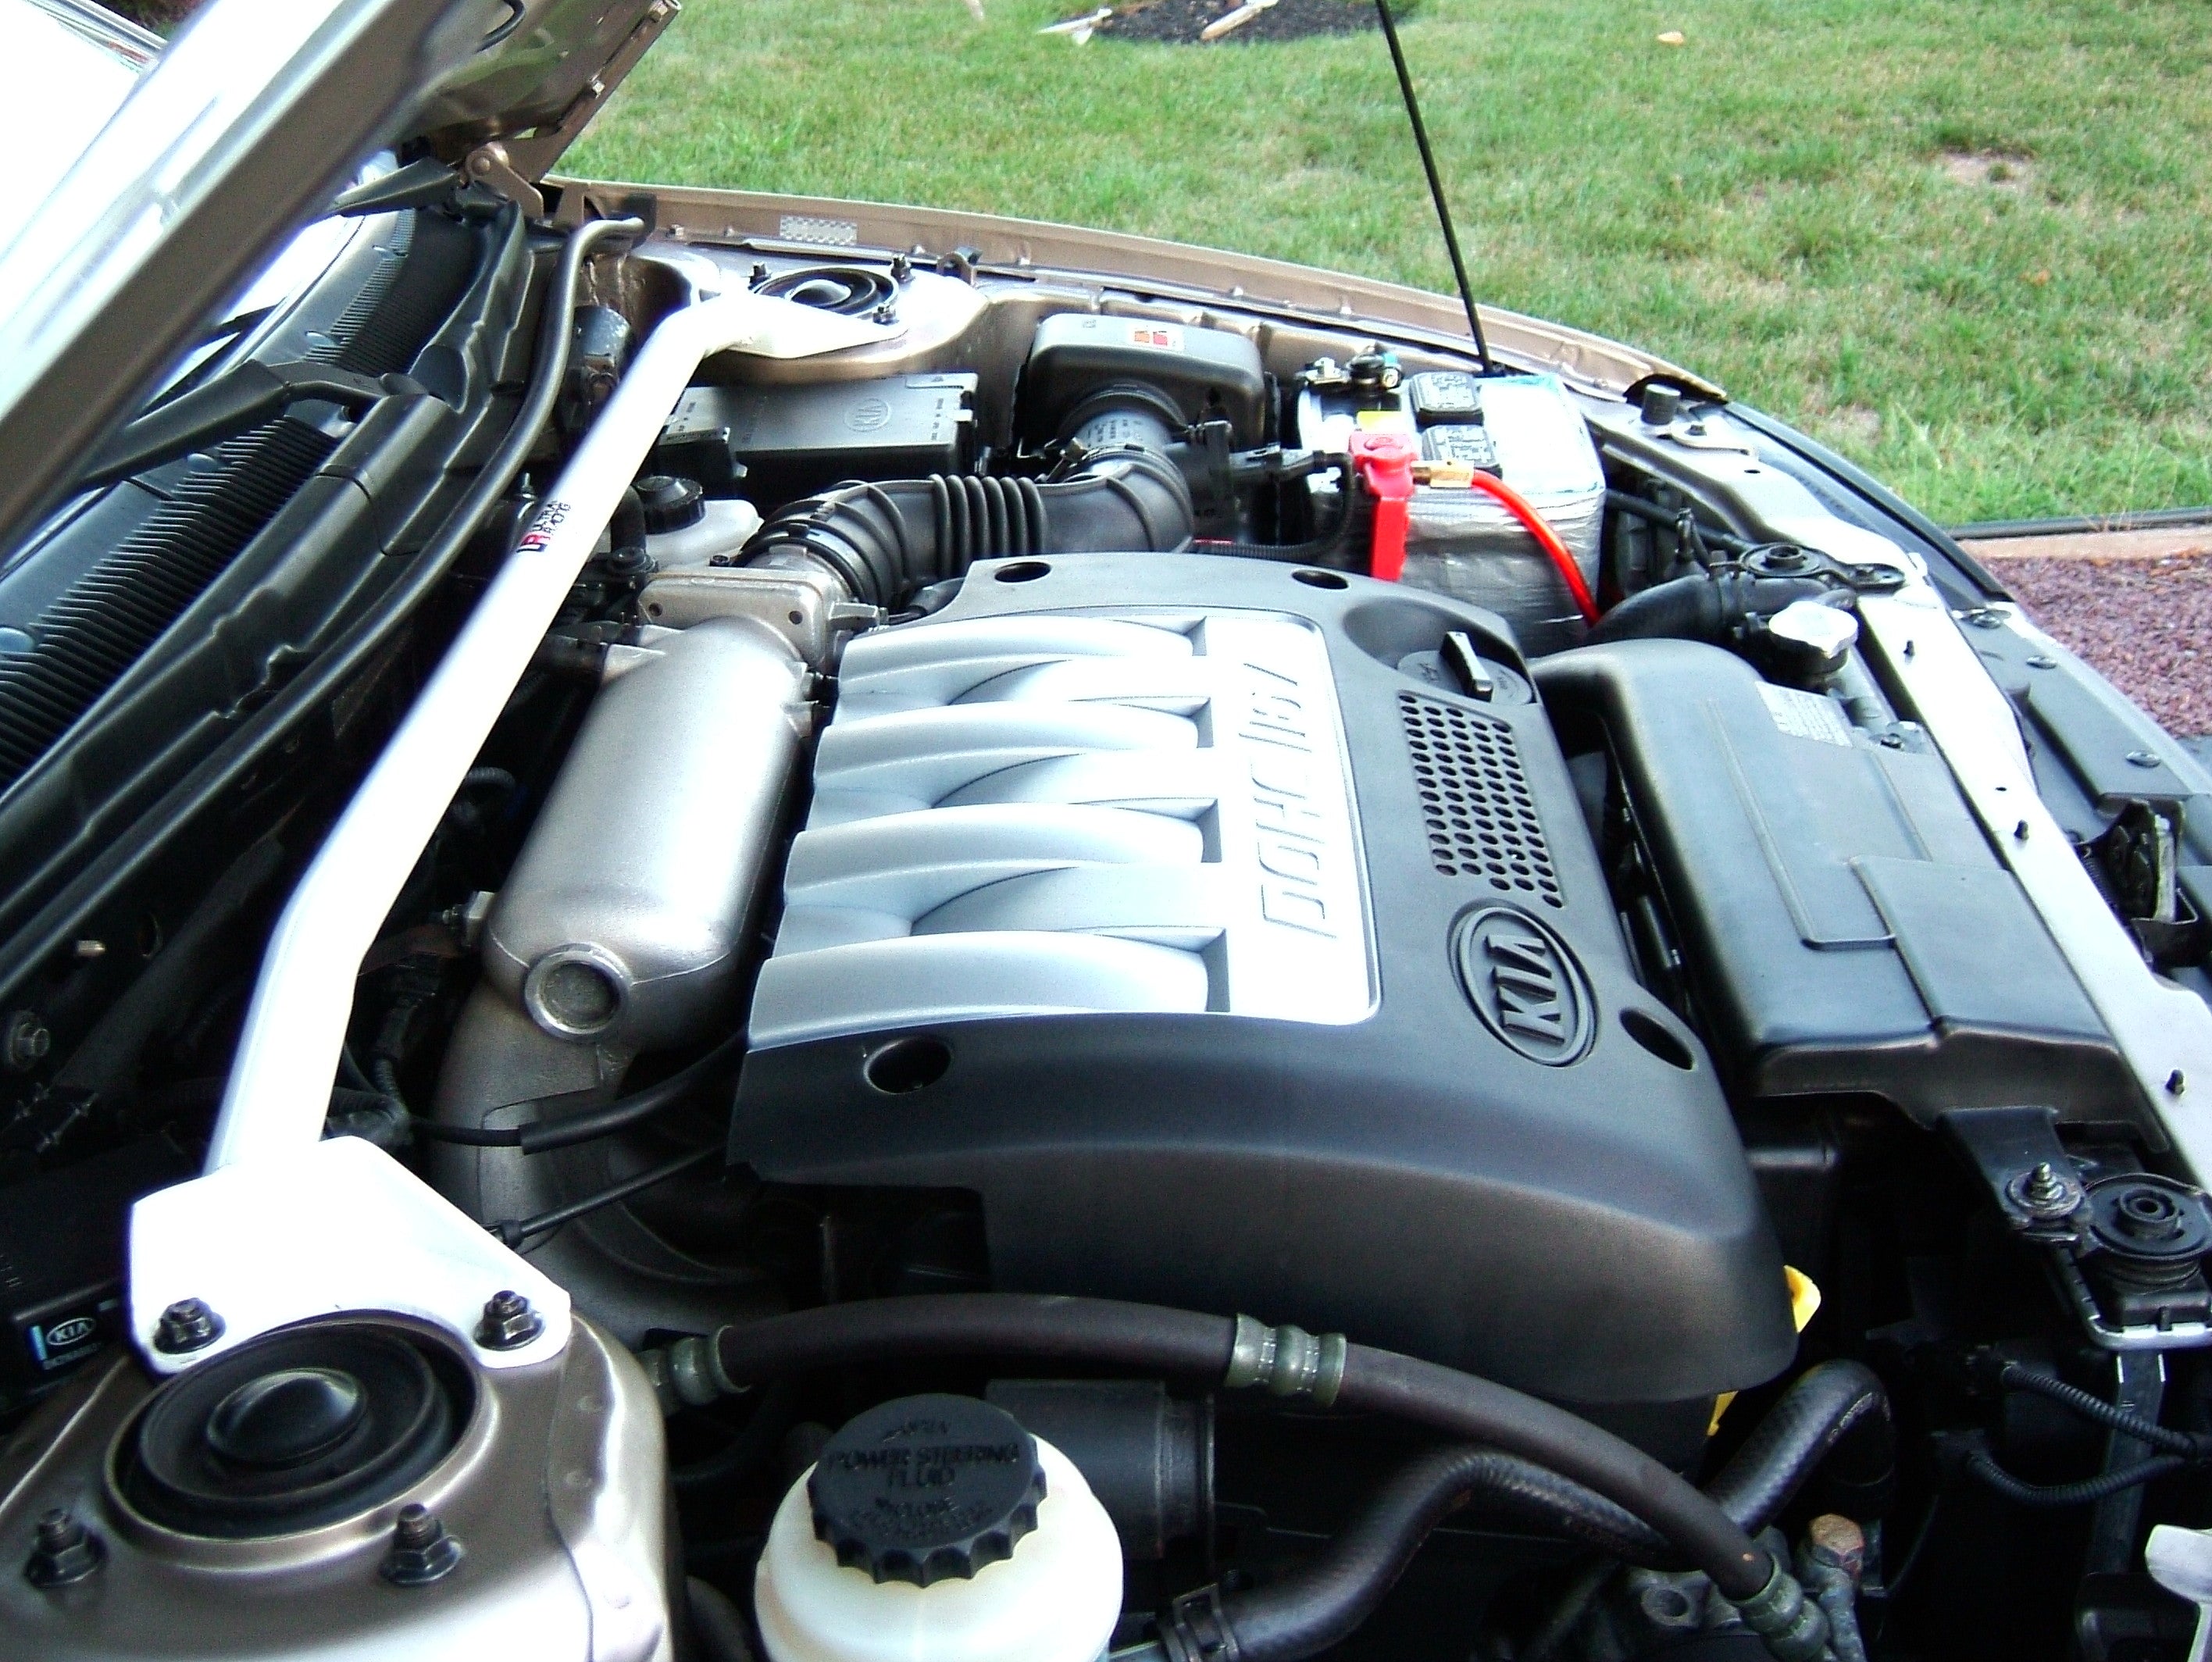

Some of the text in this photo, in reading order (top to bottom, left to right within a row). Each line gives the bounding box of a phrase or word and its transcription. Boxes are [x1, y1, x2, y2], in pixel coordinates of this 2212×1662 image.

[1483, 934, 1565, 1045] KIA
[55, 1321, 90, 1342] KIA
[830, 1443, 1019, 1471] POWER STEERING
[889, 1468, 955, 1488] FLUID
